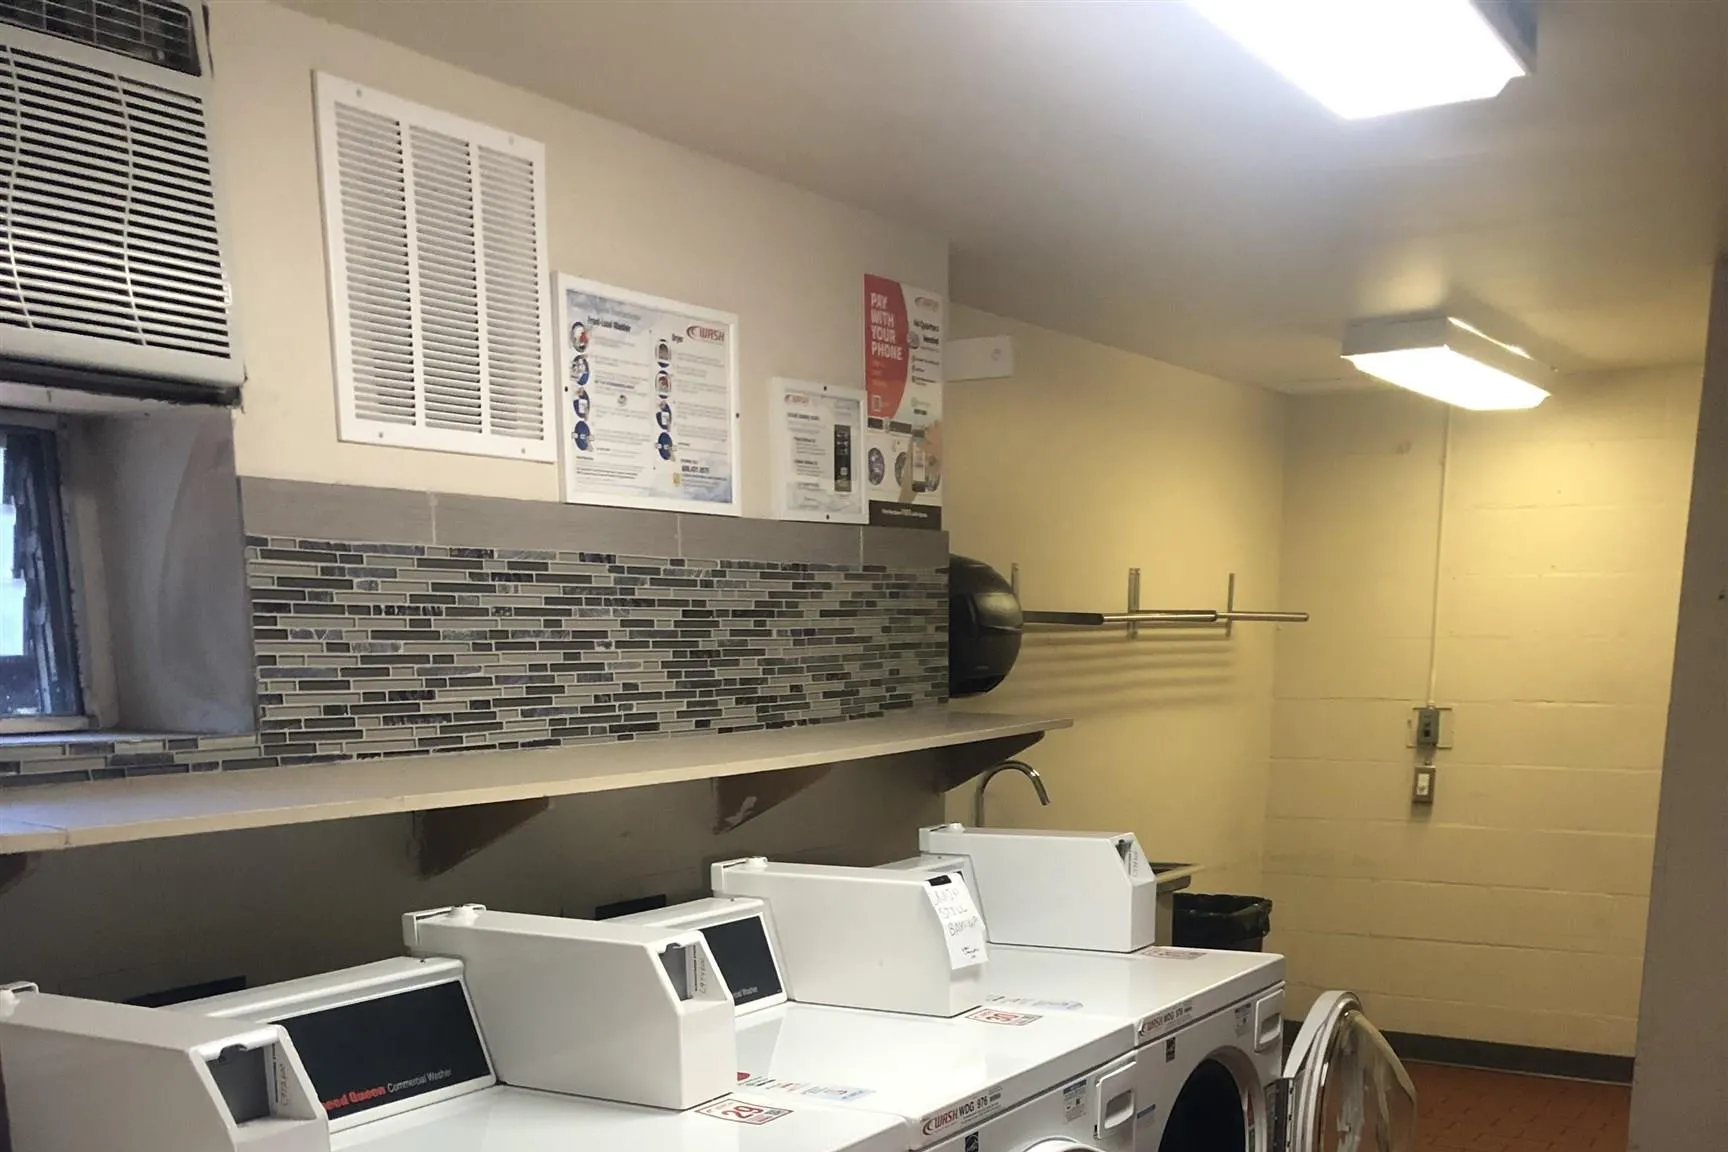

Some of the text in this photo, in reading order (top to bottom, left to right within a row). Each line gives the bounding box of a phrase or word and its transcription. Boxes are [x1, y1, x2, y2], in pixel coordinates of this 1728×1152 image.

[870, 292, 888, 309] PAY
[870, 308, 895, 328] WITH
[699, 327, 725, 342] WASH
[871, 324, 897, 344] YOUR
[871, 344, 903, 360] PHONE
[321, 1069, 452, 1111] eed Queen Commercial Washer
[721, 1105, 764, 1119] 29
[934, 1108, 958, 1129] WASH
[958, 1101, 975, 1119] WDG
